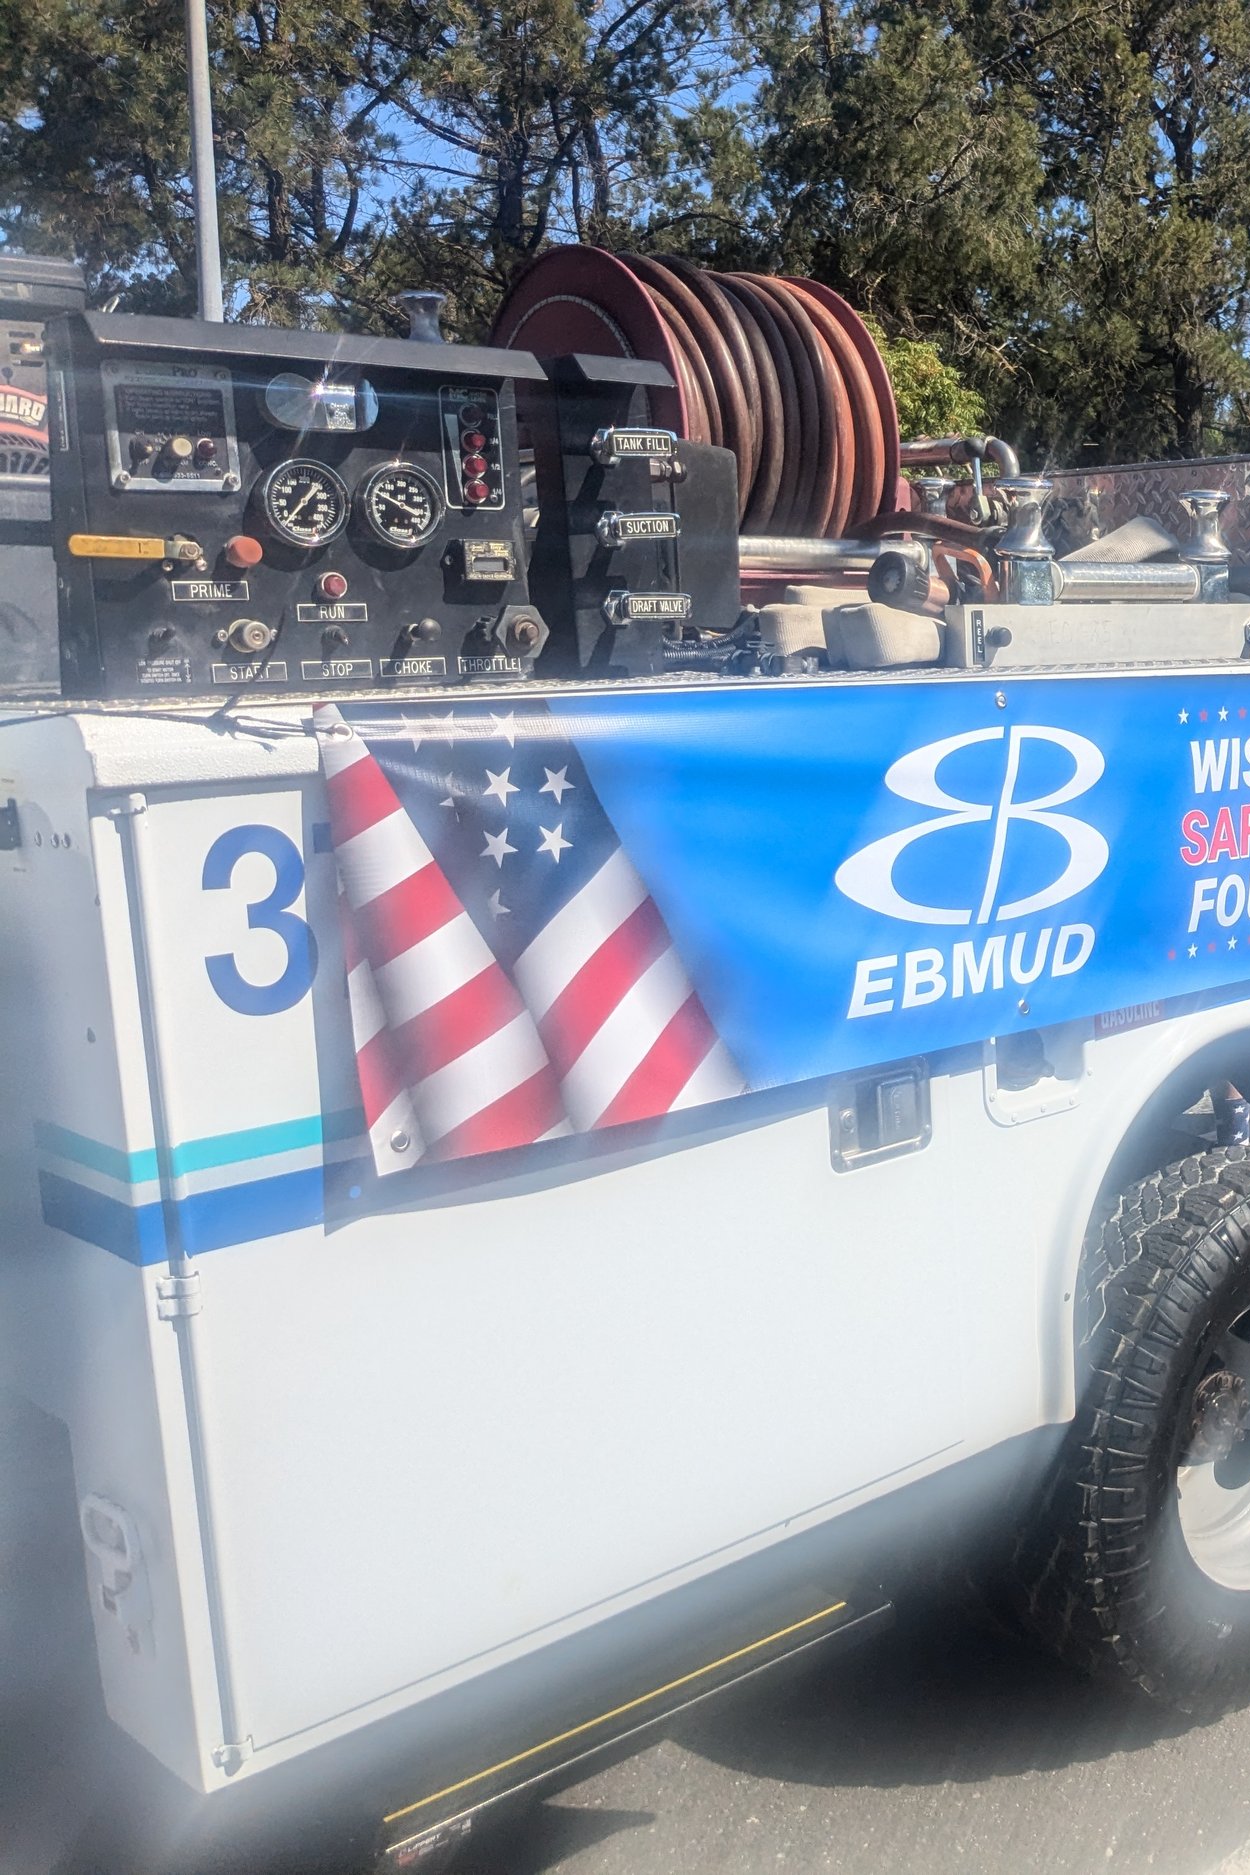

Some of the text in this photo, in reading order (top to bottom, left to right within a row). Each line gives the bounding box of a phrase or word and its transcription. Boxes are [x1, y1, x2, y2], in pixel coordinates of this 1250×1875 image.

[617, 437, 669, 451] TANK FILL
[627, 520, 670, 534] SUCTION
[190, 584, 233, 598] PRIME
[320, 605, 346, 619] RUN
[632, 600, 683, 613] DRAFT VALVE
[321, 664, 354, 677] STOP
[394, 660, 433, 675] CHOKE
[461, 658, 518, 673] THROTTLE
[202, 824, 319, 1017] 3
[846, 922, 1096, 1020] EBMUD
